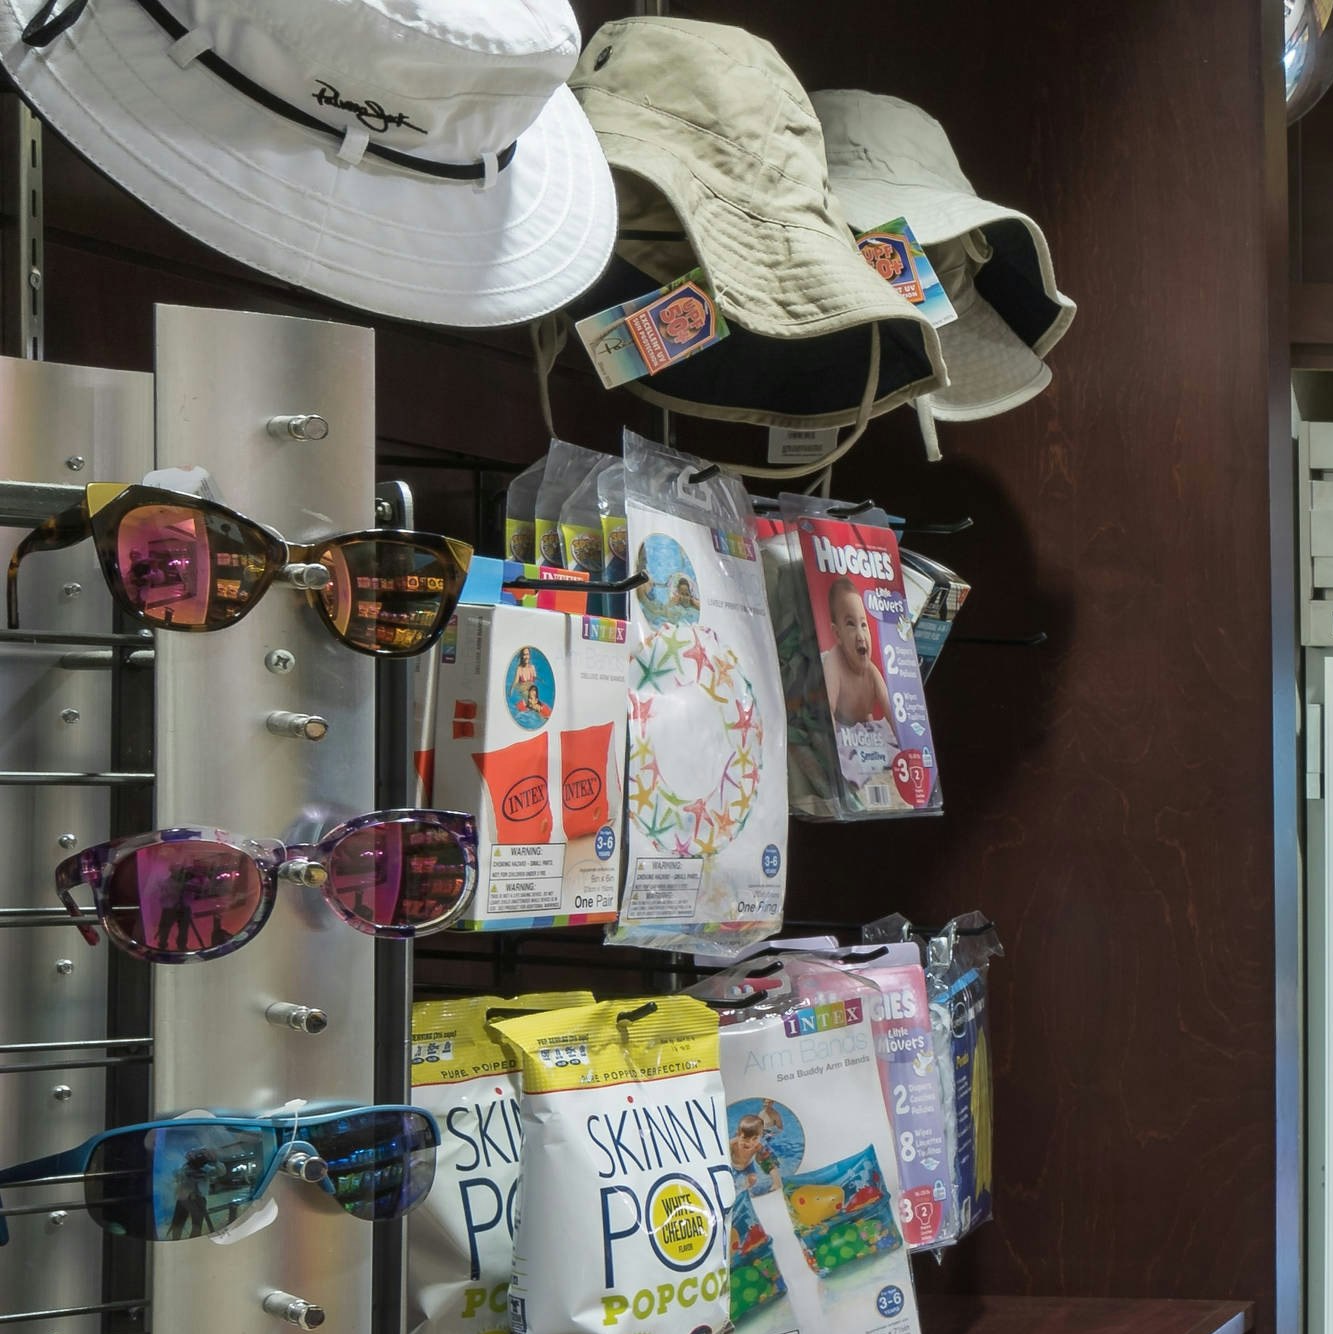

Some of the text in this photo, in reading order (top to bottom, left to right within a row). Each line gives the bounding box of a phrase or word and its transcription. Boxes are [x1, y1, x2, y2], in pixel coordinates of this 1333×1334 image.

[639, 312, 659, 353] EXCELLENT
[713, 529, 756, 560] INTEX
[812, 535, 895, 582] HUGGIES
[868, 593, 905, 614] Movers
[583, 616, 626, 641] INTEX
[884, 645, 899, 676] 2
[894, 692, 907, 723] 8
[840, 728, 884, 747] HUGGIES
[506, 785, 546, 813] INTEX
[562, 776, 597, 800] INTEX
[511, 846, 543, 857] WARNING:
[597, 838, 613, 850] 3-6
[765, 856, 778, 867] 3-6
[506, 882, 536, 892] WARNING:
[574, 895, 592, 909] One
[596, 894, 613, 907] Pair
[737, 901, 756, 913] One
[786, 1004, 861, 1036] INTEX
[887, 1027, 909, 1040] Little
[743, 1029, 869, 1076] Arm Bands
[441, 1068, 469, 1079] PURE
[640, 1058, 701, 1078] PERFECTION
[776, 1055, 871, 1083] Sea Buddy Arm Bands
[893, 1084, 911, 1115] 2
[587, 1094, 725, 1179] SKINNY
[901, 1131, 916, 1162] 8
[661, 1193, 692, 1216] WHITE
[662, 1217, 704, 1245] CHEDDAR
[878, 1293, 902, 1310] 3-6
